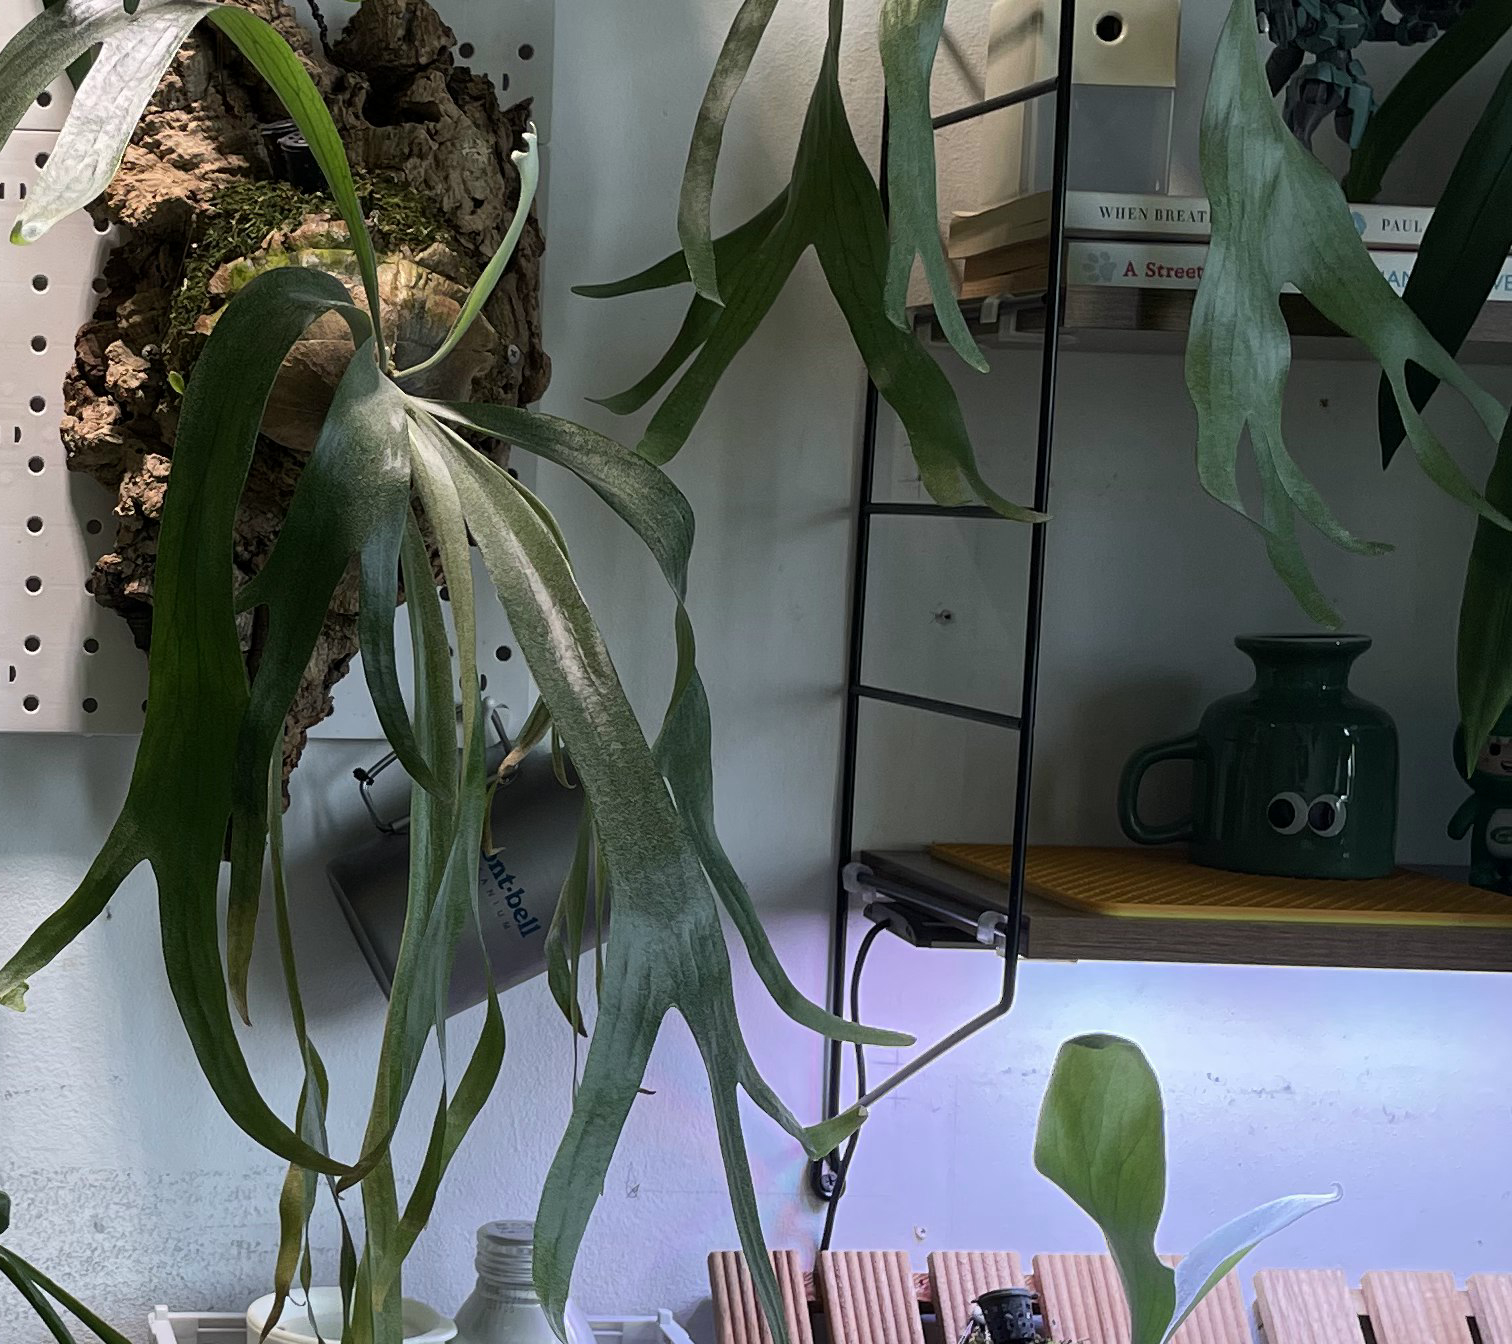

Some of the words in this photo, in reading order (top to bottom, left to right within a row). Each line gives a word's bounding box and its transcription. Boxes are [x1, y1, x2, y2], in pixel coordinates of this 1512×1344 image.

[1098, 205, 1149, 221] WHEN
[1154, 208, 1211, 224] BREAT
[1381, 217, 1423, 233] PAUL
[1122, 259, 1138, 277] A
